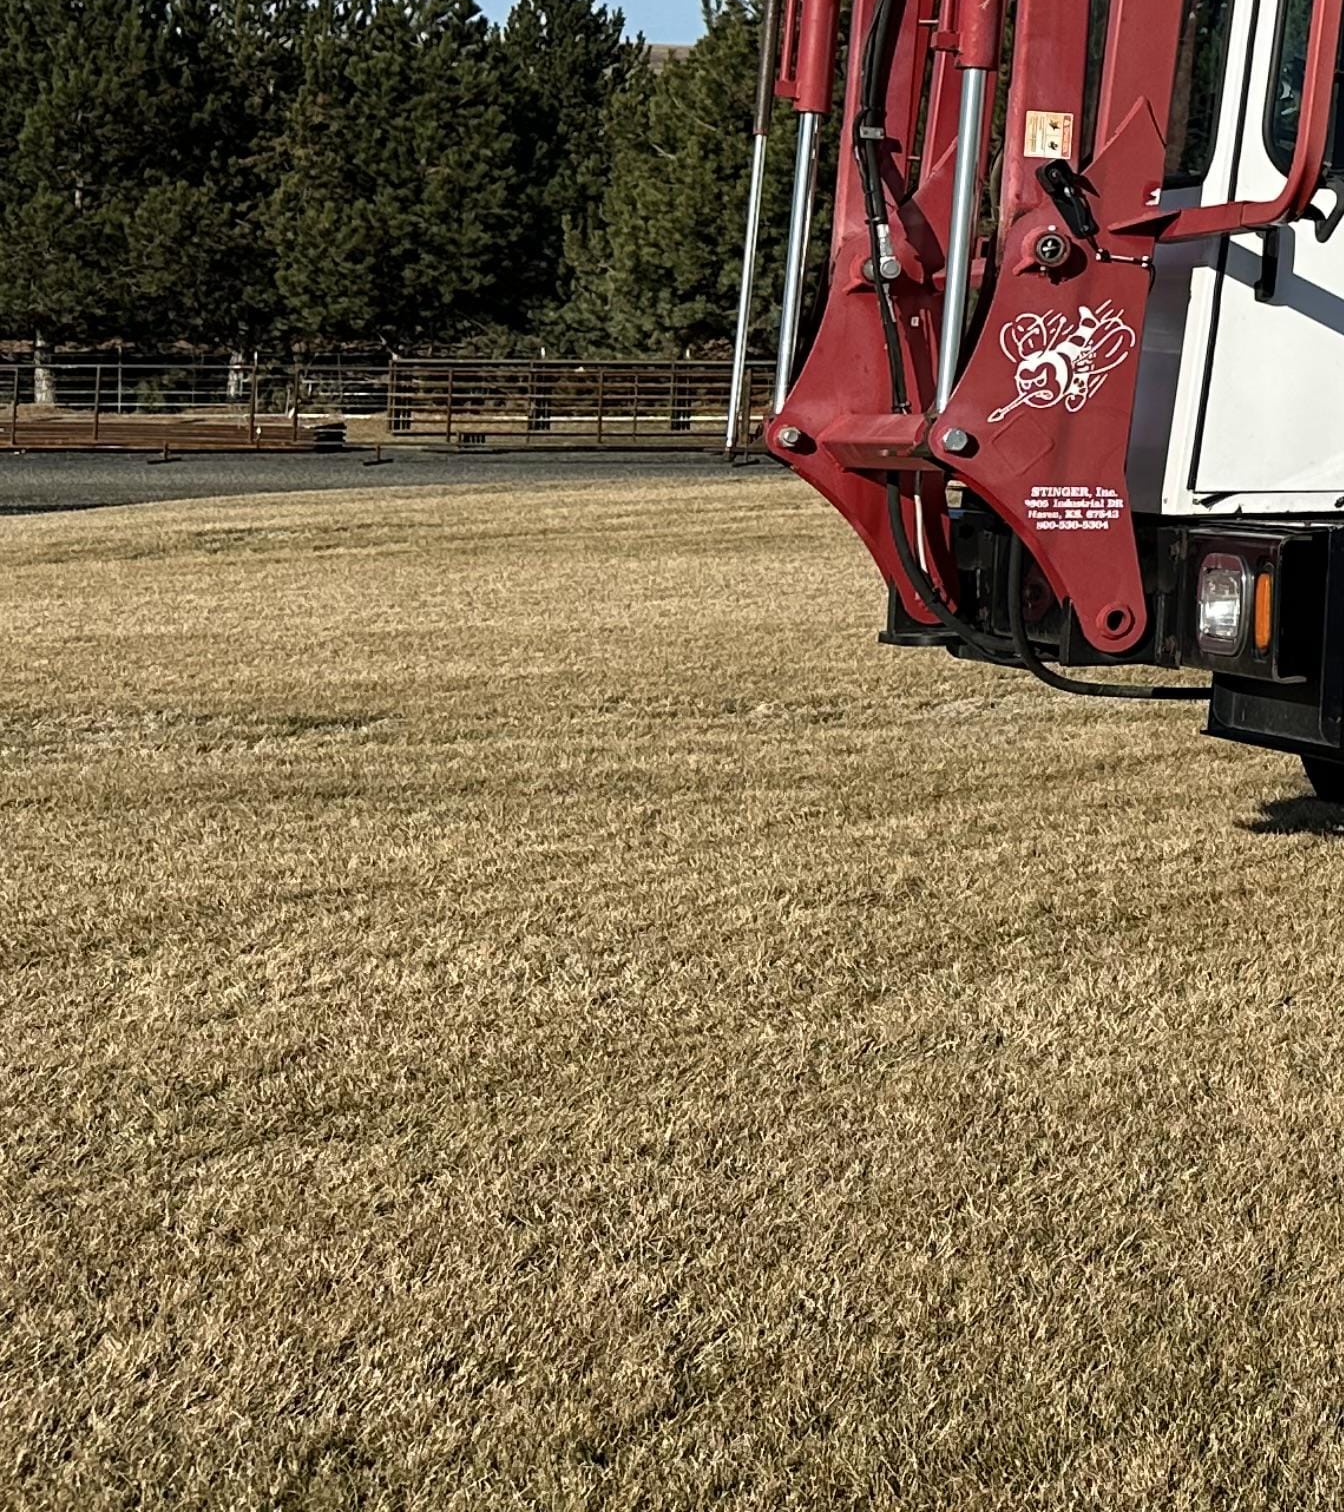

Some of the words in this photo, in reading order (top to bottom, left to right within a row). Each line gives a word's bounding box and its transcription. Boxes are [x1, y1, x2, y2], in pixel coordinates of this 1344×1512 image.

[1031, 487, 1092, 498] STINGER,
[1096, 487, 1118, 497] Inc.
[1053, 499, 1104, 508] Industrial
[1107, 499, 1123, 508] DR
